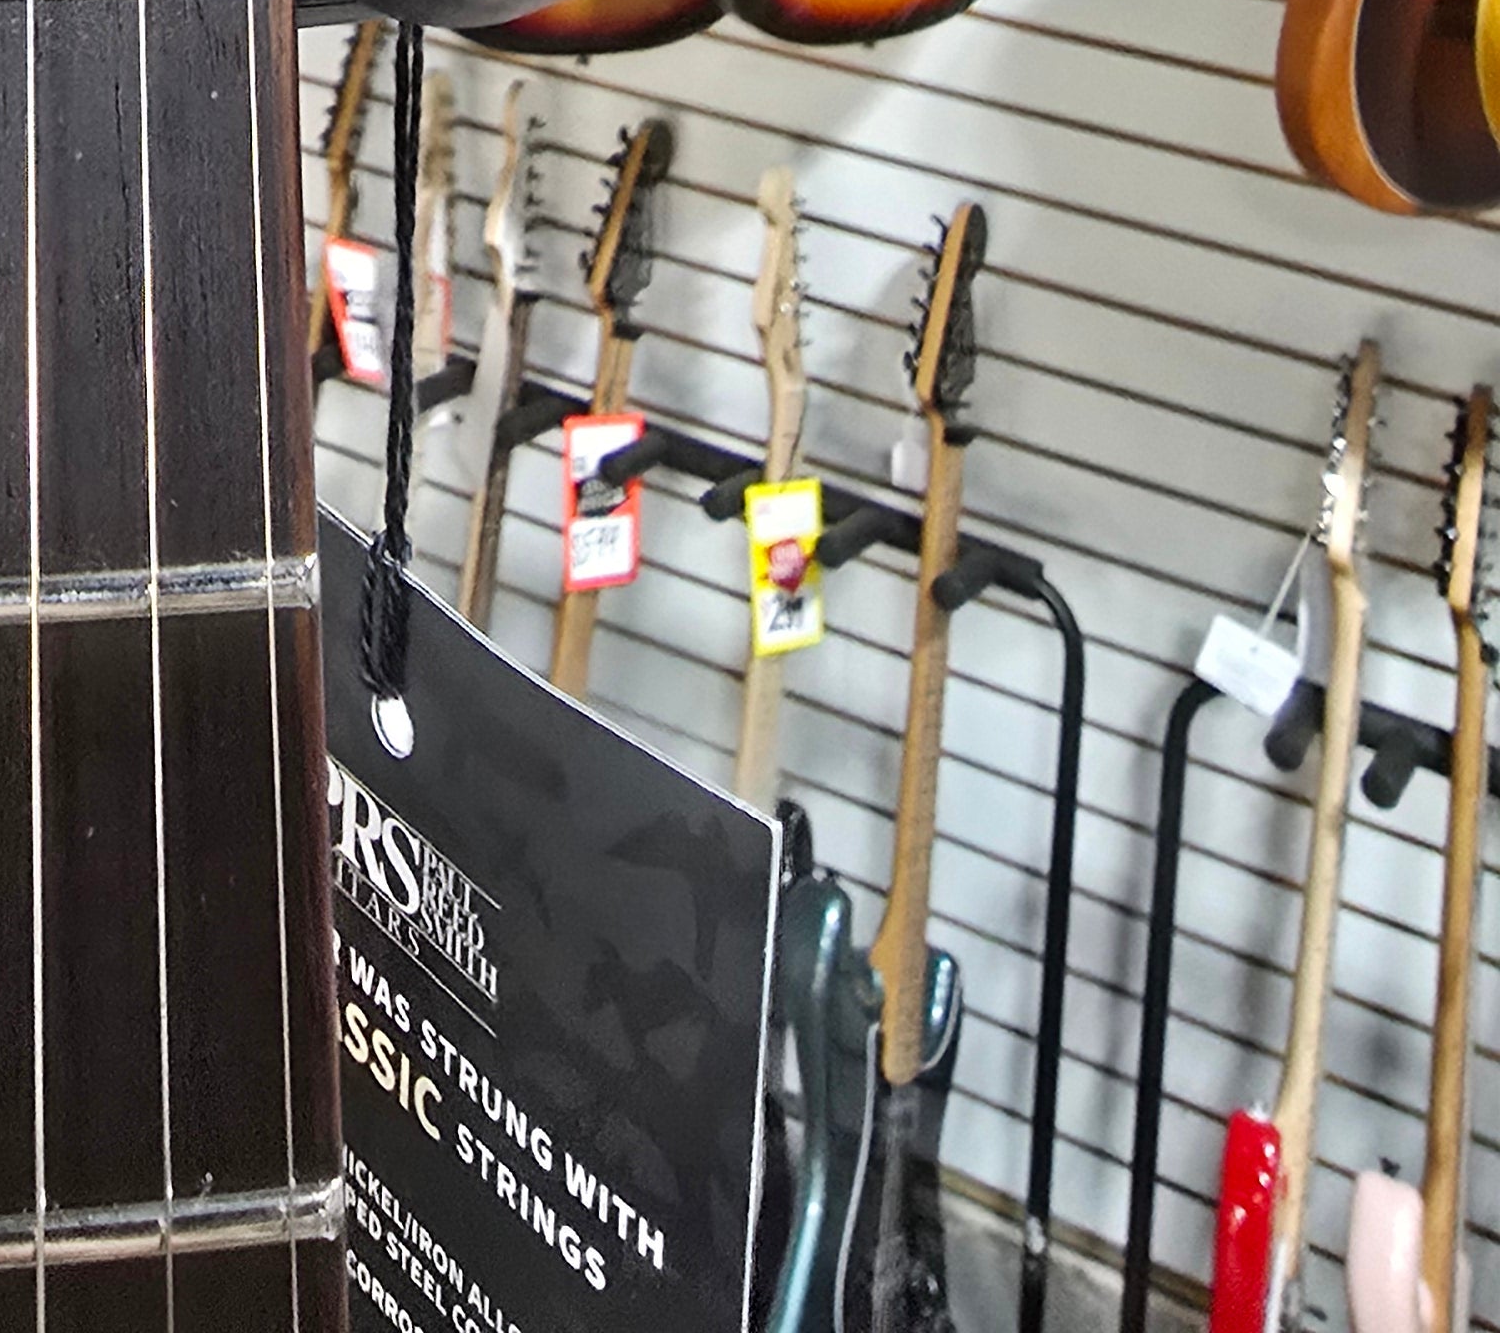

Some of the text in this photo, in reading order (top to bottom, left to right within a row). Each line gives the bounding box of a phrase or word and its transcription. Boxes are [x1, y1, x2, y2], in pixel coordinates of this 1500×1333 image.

[337, 997, 607, 1292] SSIC STRINGS
[349, 945, 667, 1271] WAS STRUNG WITH
[385, 1233, 448, 1317] STEEL
